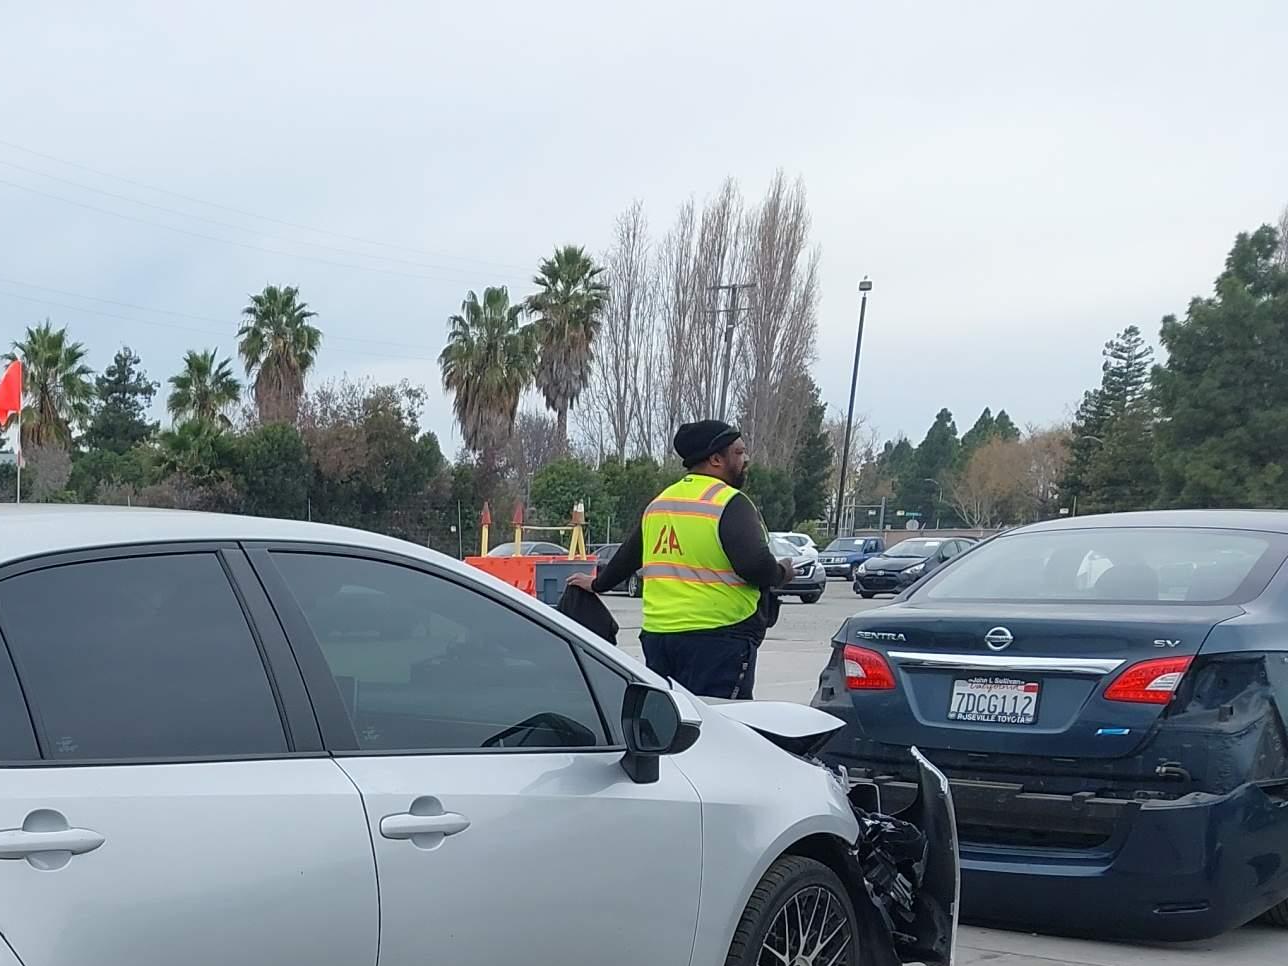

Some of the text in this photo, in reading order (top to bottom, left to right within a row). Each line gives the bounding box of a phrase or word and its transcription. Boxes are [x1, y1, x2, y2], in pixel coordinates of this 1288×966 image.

[855, 631, 906, 641] SENTRA
[1153, 639, 1181, 648] SV
[955, 692, 1033, 716] 7DCG112
[998, 715, 1025, 724] TOYOTA
